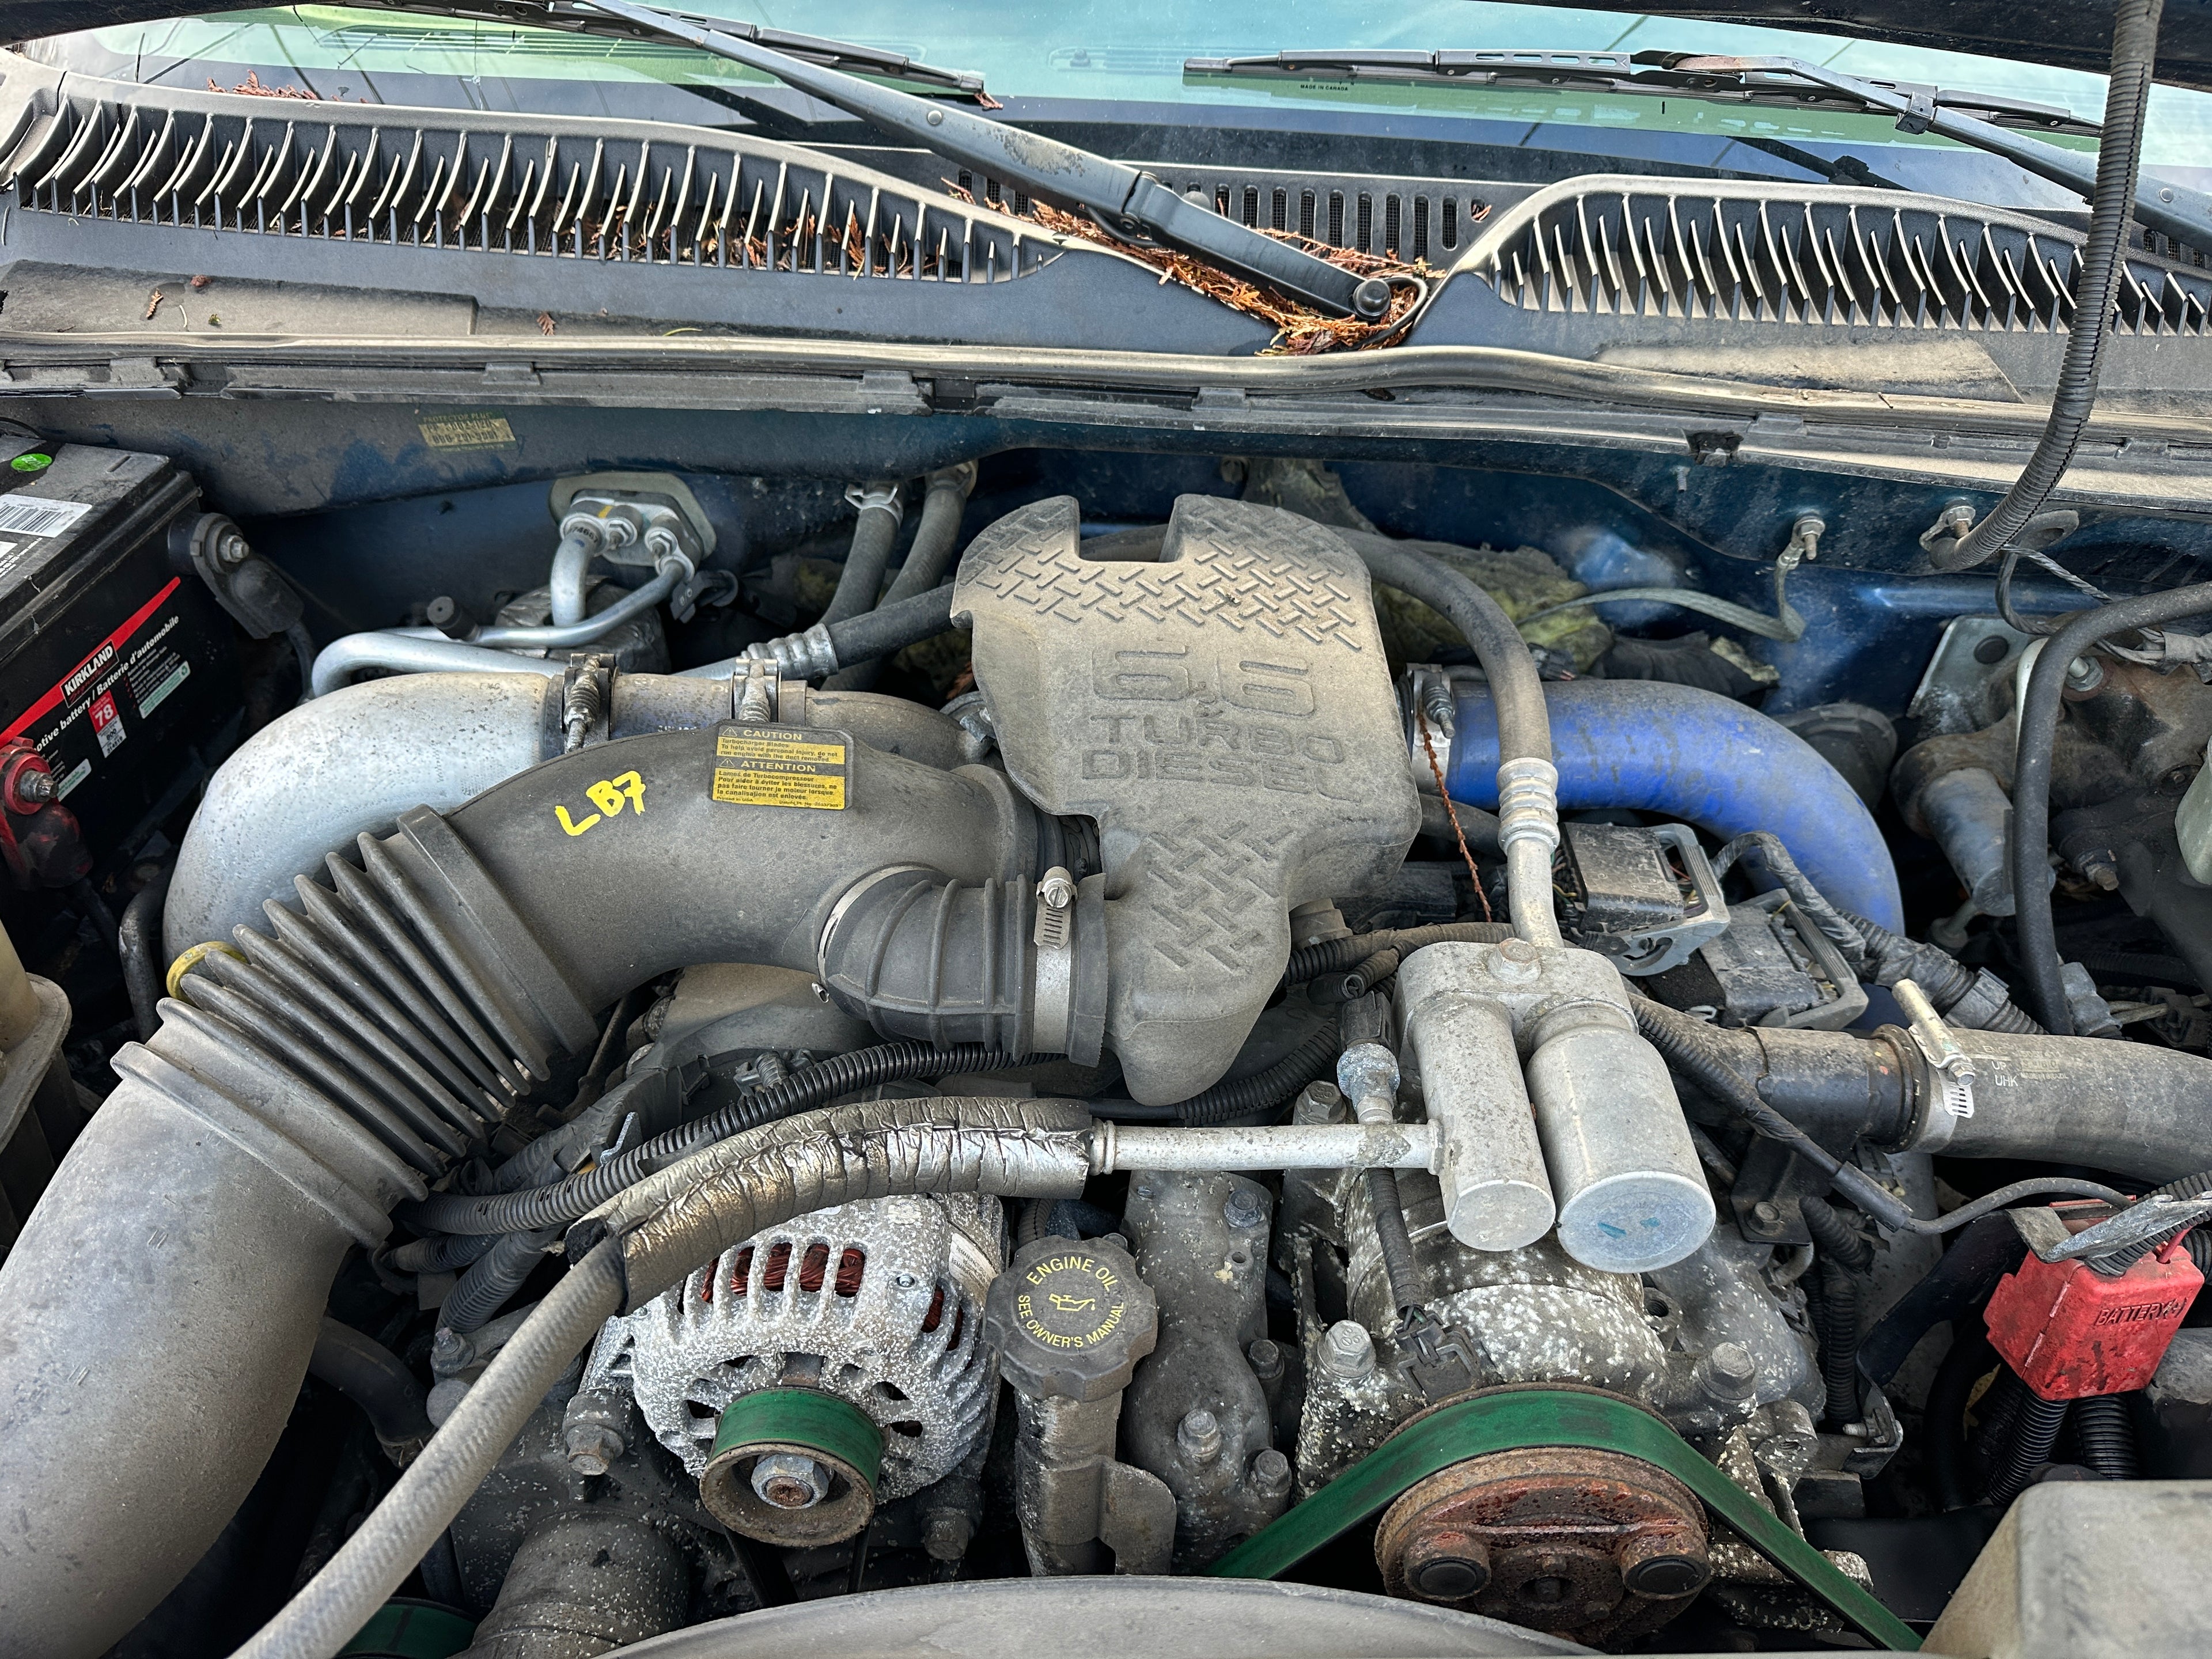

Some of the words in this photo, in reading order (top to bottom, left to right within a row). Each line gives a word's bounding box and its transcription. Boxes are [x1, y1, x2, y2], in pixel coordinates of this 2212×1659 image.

[60, 696, 90, 730] battery
[92, 690, 95, 700] /
[97, 662, 129, 695] Batterie
[130, 615, 179, 665] d'automobile
[64, 645, 113, 696] KIRKLAND
[94, 703, 113, 726] 78
[722, 738, 764, 747] Turbocharger
[744, 729, 802, 740] CAUTION
[1090, 713, 1346, 765] TURBO
[741, 760, 816, 772] ATTENTION
[753, 773, 814, 782] Turbocompresseur
[1082, 748, 1363, 805] DIESEL
[555, 770, 646, 836] LB7
[1982, 1045, 2008, 1055] ENG
[1991, 1060, 2006, 1070] UP
[1995, 1074, 2018, 1087] UHK
[1026, 1256, 1095, 1285] ENGINE
[1095, 1267, 1118, 1291] OIL
[1018, 1294, 1033, 1319] SEE
[1026, 1319, 1084, 1348] OWNER'S
[1086, 1302, 1124, 1344] MANUAL
